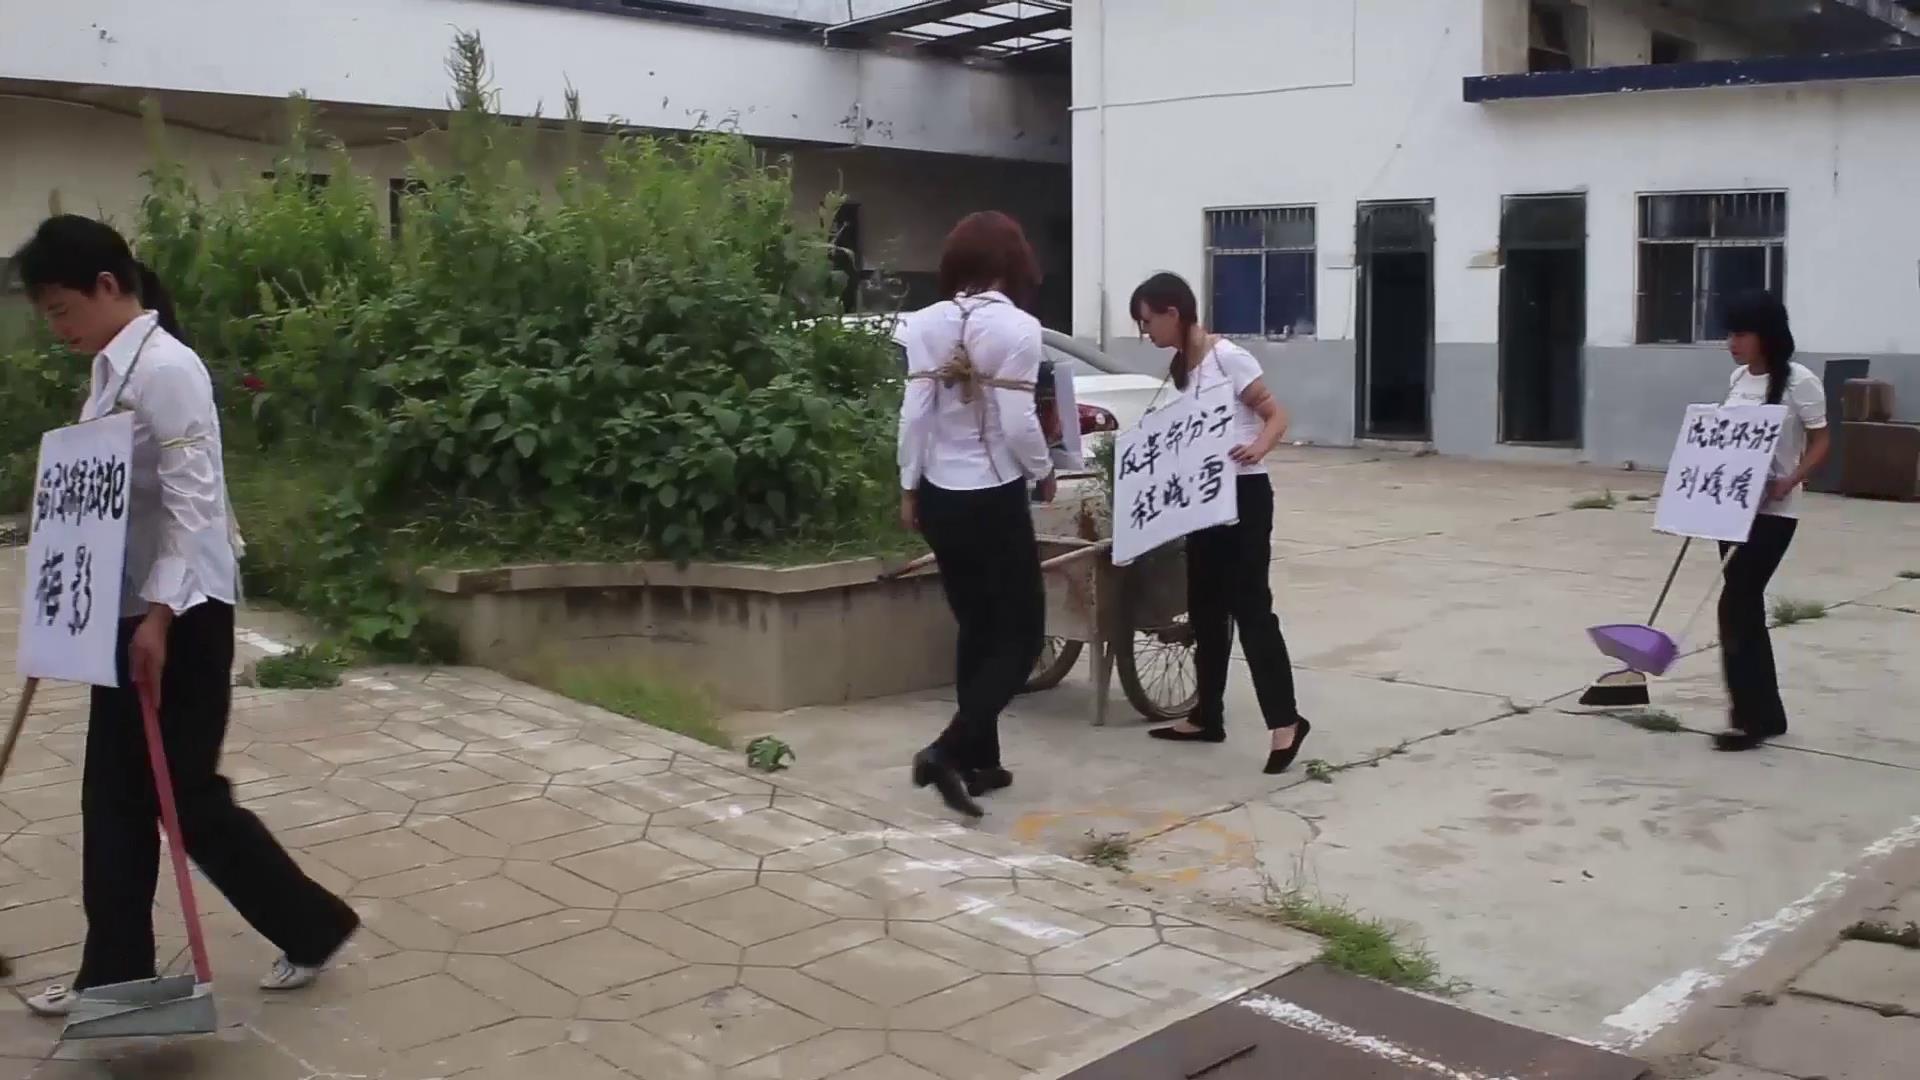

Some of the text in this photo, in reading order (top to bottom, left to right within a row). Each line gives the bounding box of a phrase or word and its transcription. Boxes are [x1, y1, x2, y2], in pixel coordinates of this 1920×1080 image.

[1119, 405, 1234, 480] 反革命分子
[1130, 454, 1224, 530] 程晓雪
